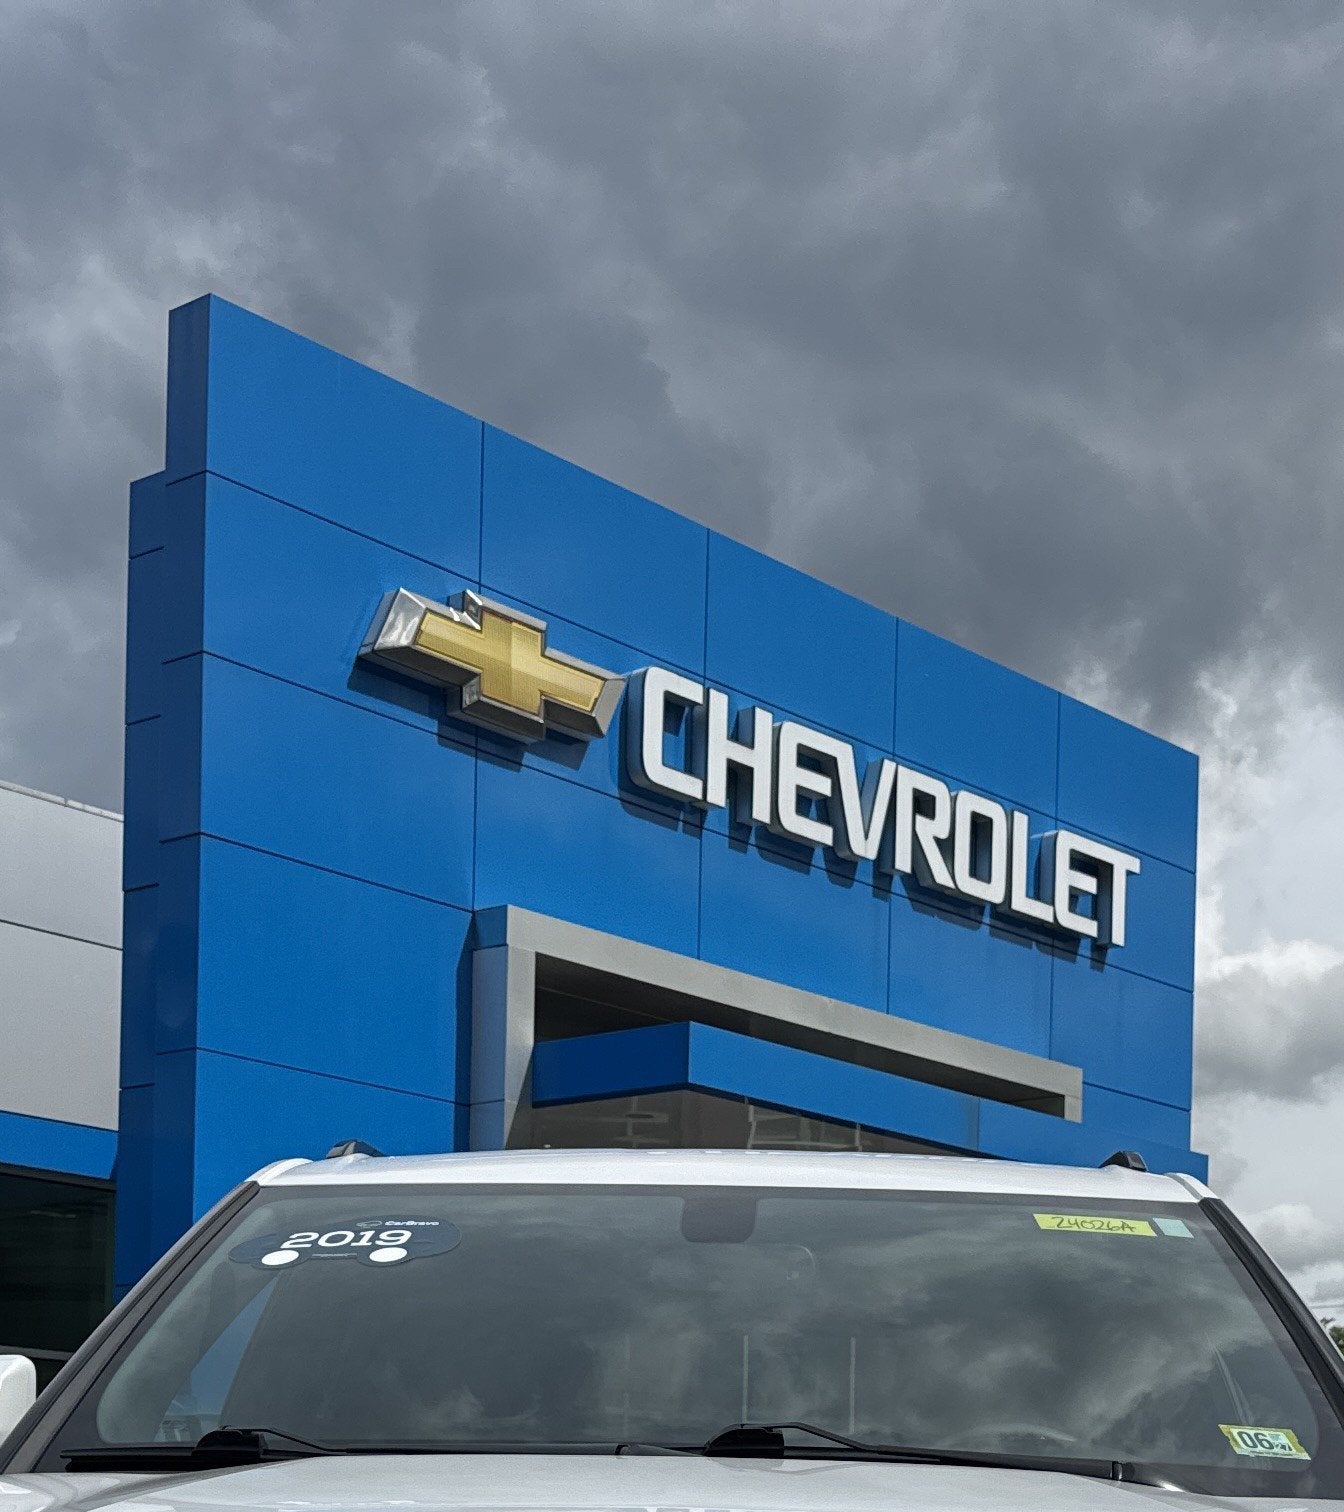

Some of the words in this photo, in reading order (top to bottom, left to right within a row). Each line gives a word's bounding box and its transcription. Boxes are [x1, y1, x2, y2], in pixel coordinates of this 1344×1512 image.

[632, 665, 1142, 948] CHEVROLET
[279, 1229, 413, 1249] 2019
[1236, 1430, 1275, 1450] 06
